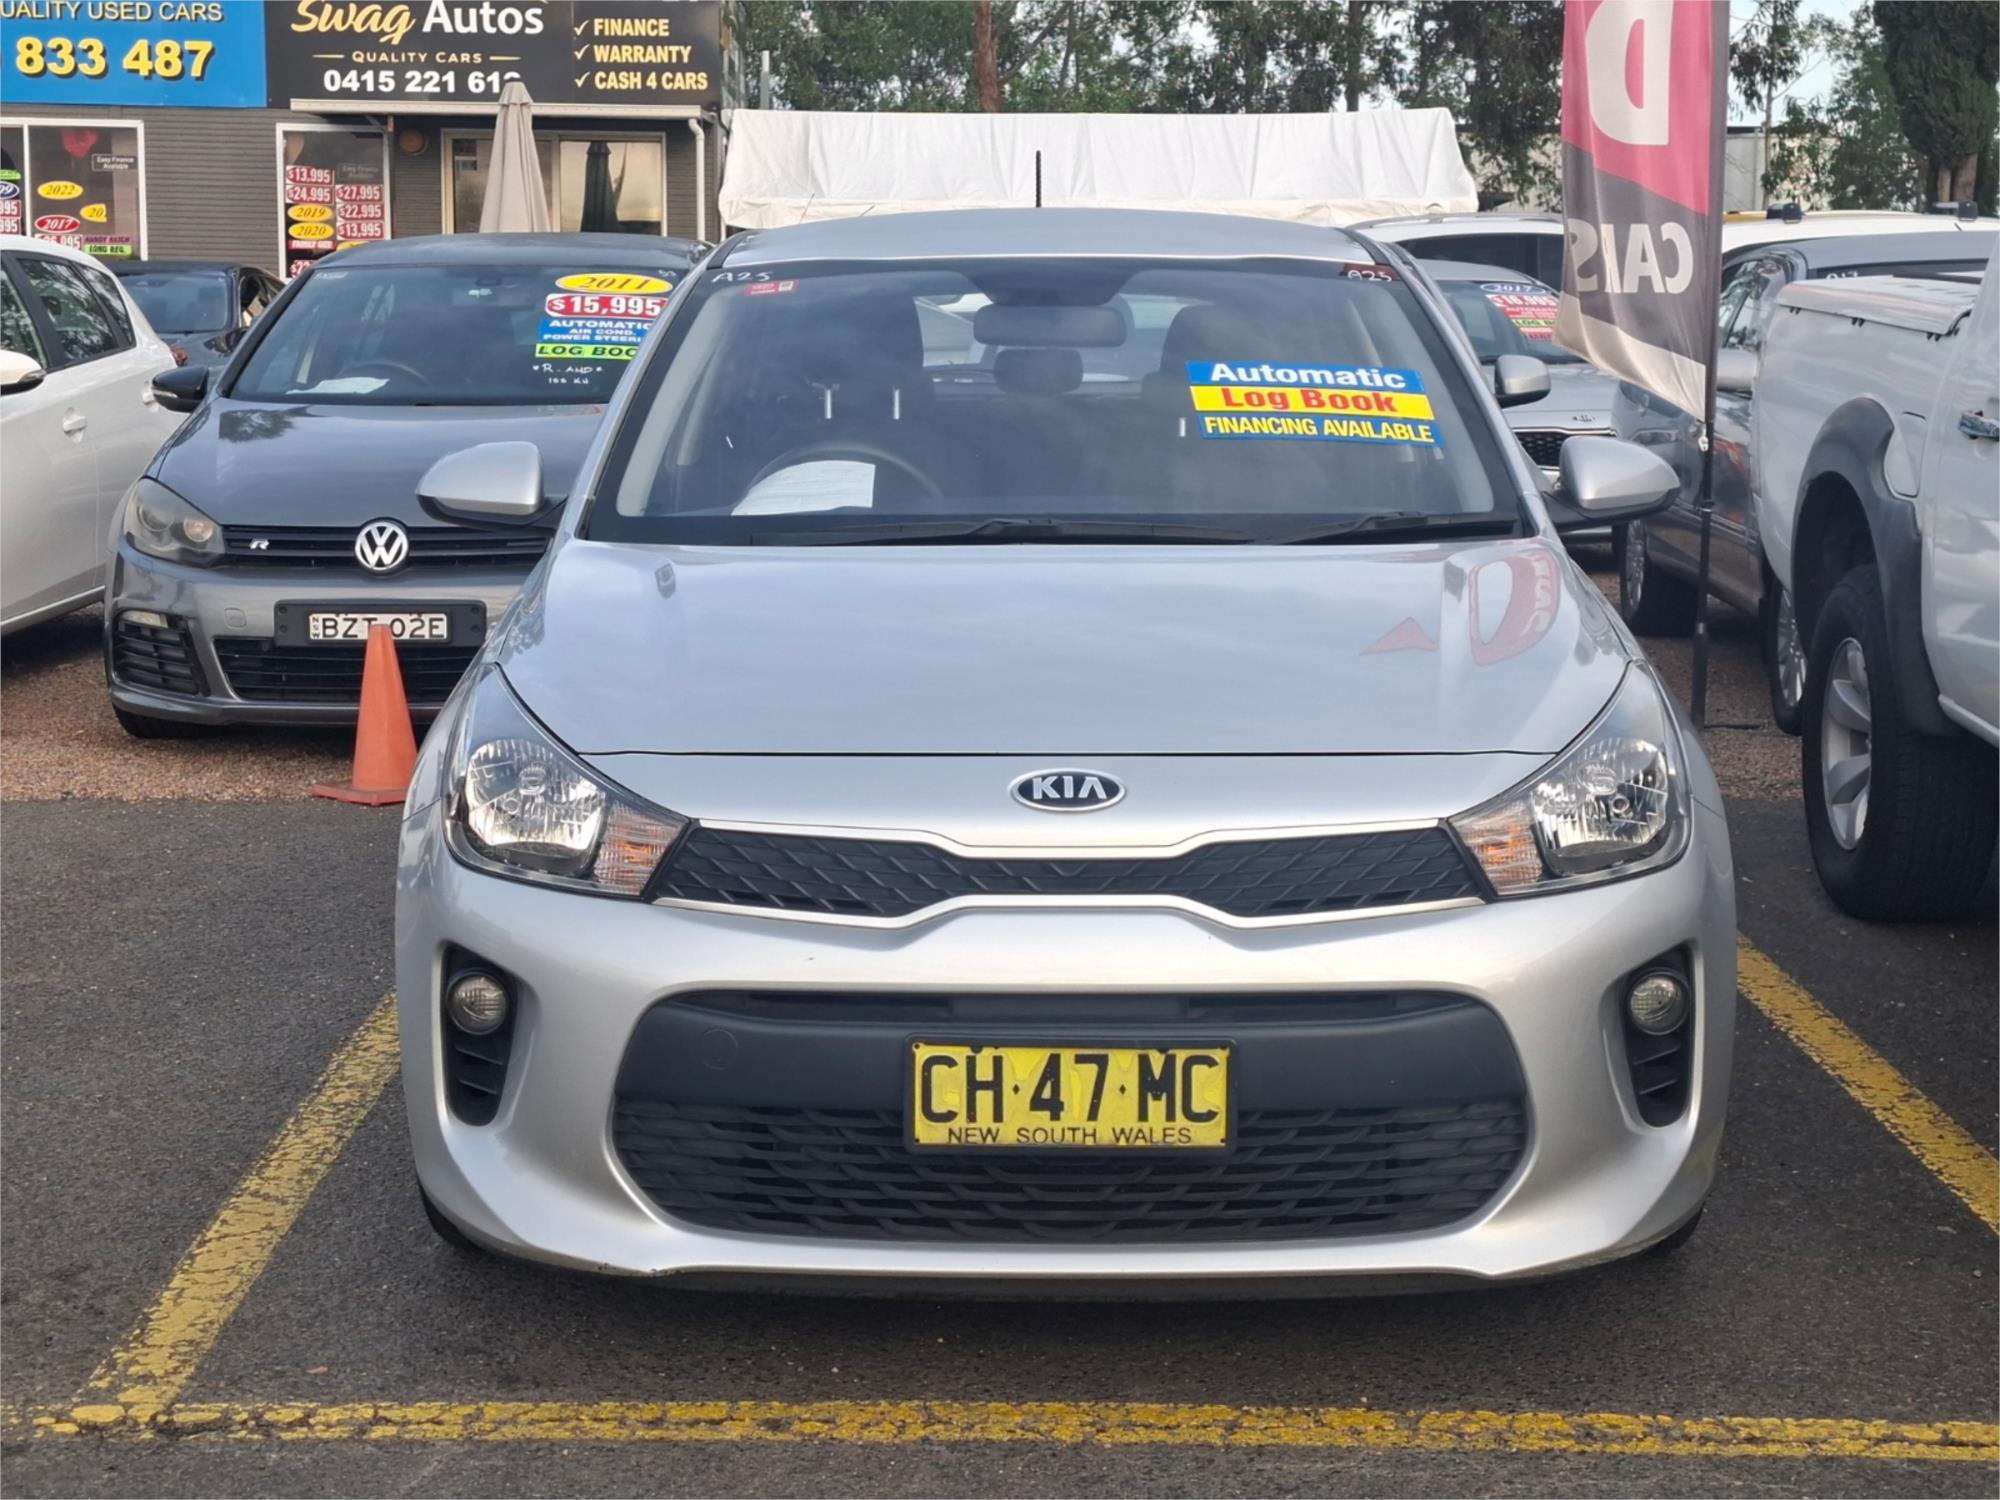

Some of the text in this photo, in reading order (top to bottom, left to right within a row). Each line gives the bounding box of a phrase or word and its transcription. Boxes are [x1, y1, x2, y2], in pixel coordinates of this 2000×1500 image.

[88, 2, 152, 20] USED
[159, 3, 223, 21] CARS
[291, 0, 544, 45] Swag Autos
[593, 19, 669, 37] FINANCE
[16, 36, 213, 78] 833 487
[352, 51, 482, 64] QUALITY CARS
[593, 45, 691, 63] WARRANTY
[324, 70, 396, 92] 0415
[404, 71, 456, 93] 221
[594, 72, 708, 90] CASH 4 CARS
[288, 168, 331, 183] $13,995
[45, 185, 75, 195] 2022
[288, 186, 331, 202] $24,995
[338, 186, 380, 200] $27,995
[296, 207, 326, 218] 2019
[338, 204, 382, 218] $22,995
[45, 218, 73, 229] 2017
[297, 225, 327, 236] 2020
[338, 223, 382, 237] $13,995
[578, 277, 650, 290] 2011
[549, 296, 661, 316] $15,995
[538, 345, 582, 356] LOG
[1211, 363, 1406, 389] Automatic
[1221, 388, 1398, 413] Log Book
[1204, 417, 1435, 443] FINANCING AVAILABLE
[1032, 775, 1107, 800] KIA
[948, 1127, 1192, 1145] NEW SOUTH WALES
